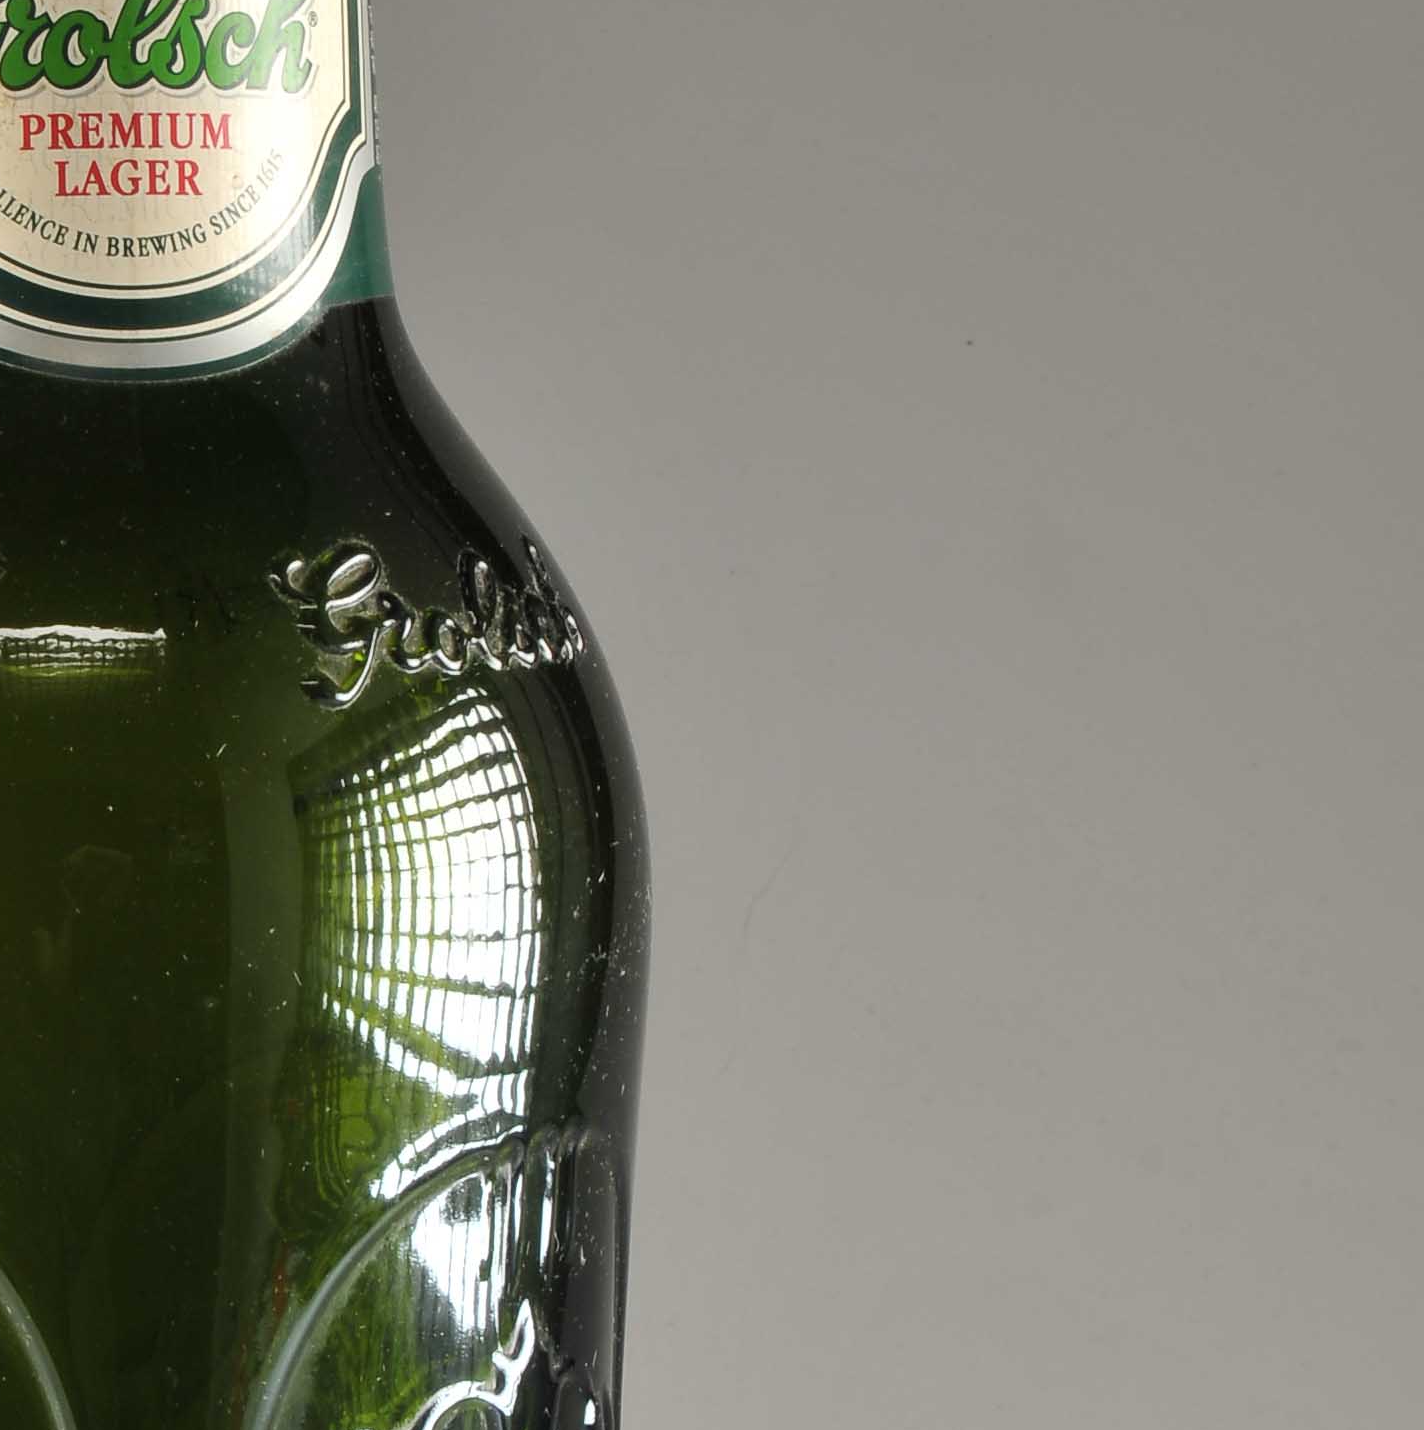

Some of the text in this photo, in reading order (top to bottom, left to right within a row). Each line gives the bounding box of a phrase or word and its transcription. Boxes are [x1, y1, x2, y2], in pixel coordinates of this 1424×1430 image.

[19, 112, 233, 151] PREMIUM
[54, 159, 203, 197] LAGER
[73, 230, 100, 254] IN
[105, 222, 208, 258] BREWING
[208, 184, 261, 236] SINCE
